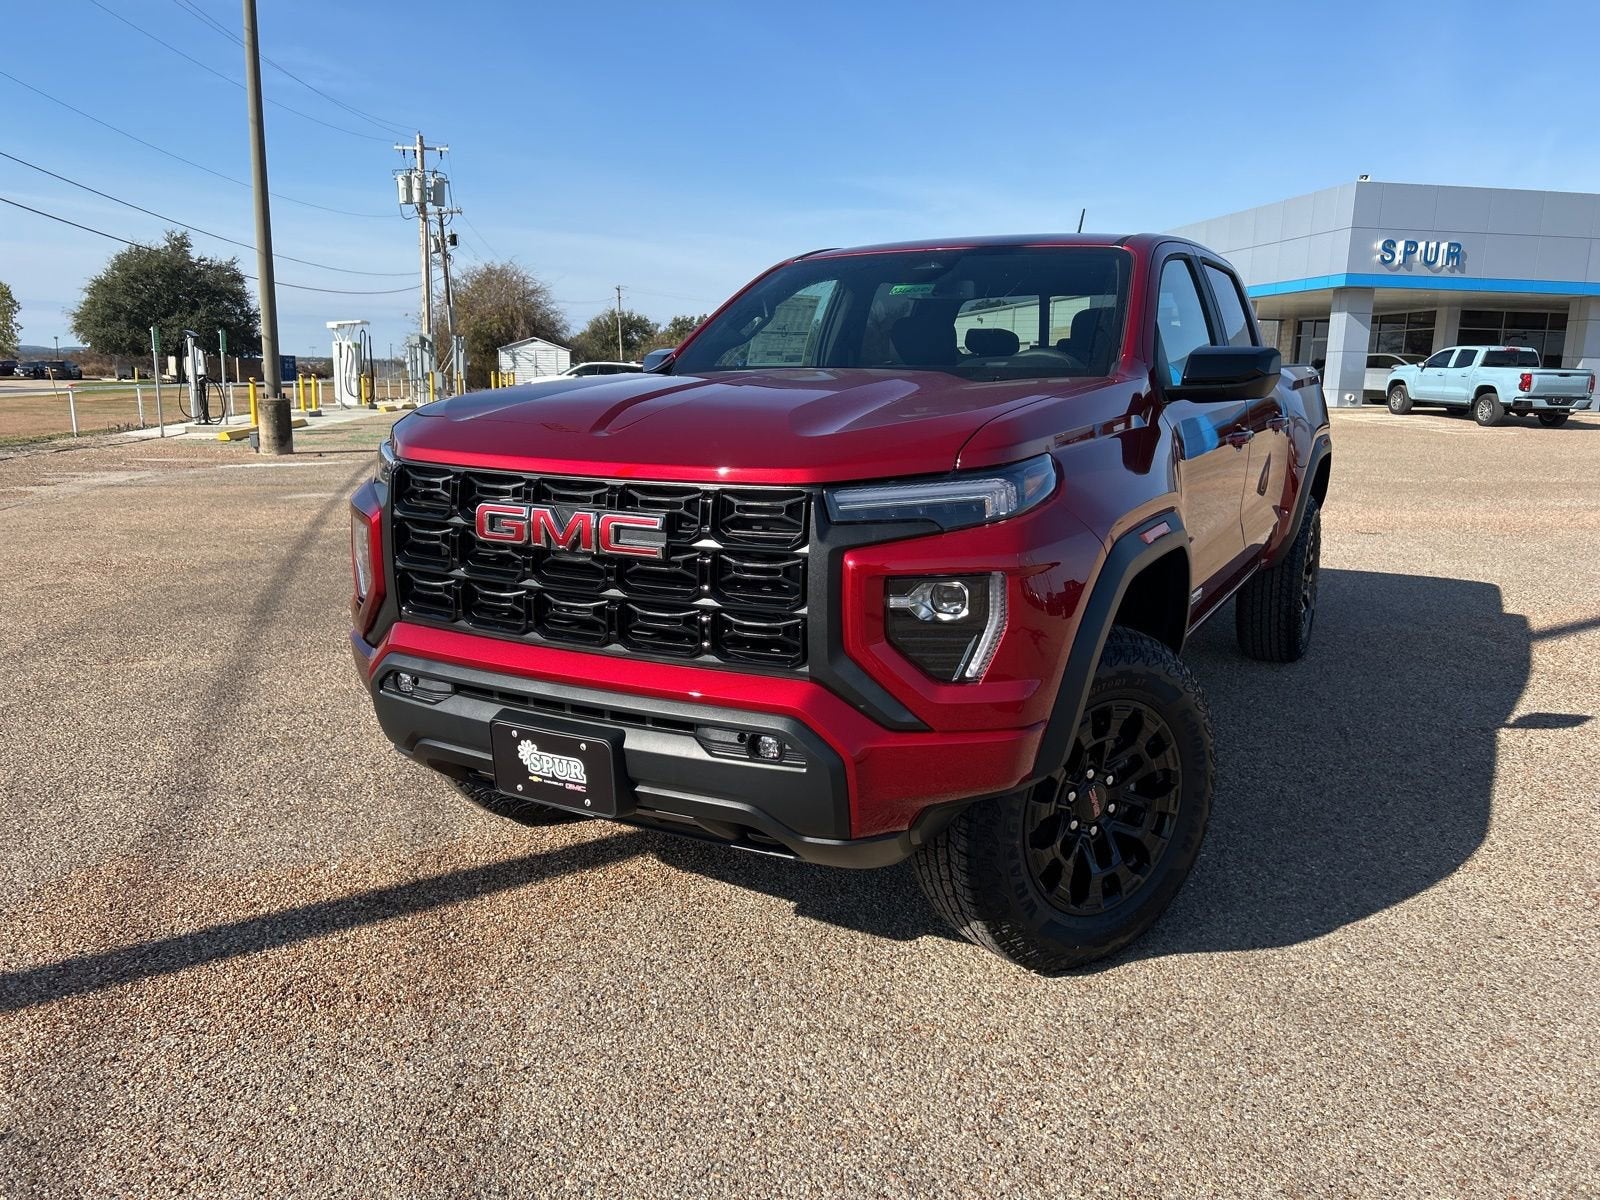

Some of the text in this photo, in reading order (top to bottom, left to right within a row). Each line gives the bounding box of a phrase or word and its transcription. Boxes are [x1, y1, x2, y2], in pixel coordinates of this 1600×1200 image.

[1380, 239, 1462, 267] SPUR
[476, 503, 664, 559] GMC
[529, 752, 586, 783] SPUR
[565, 782, 587, 793] GMC
